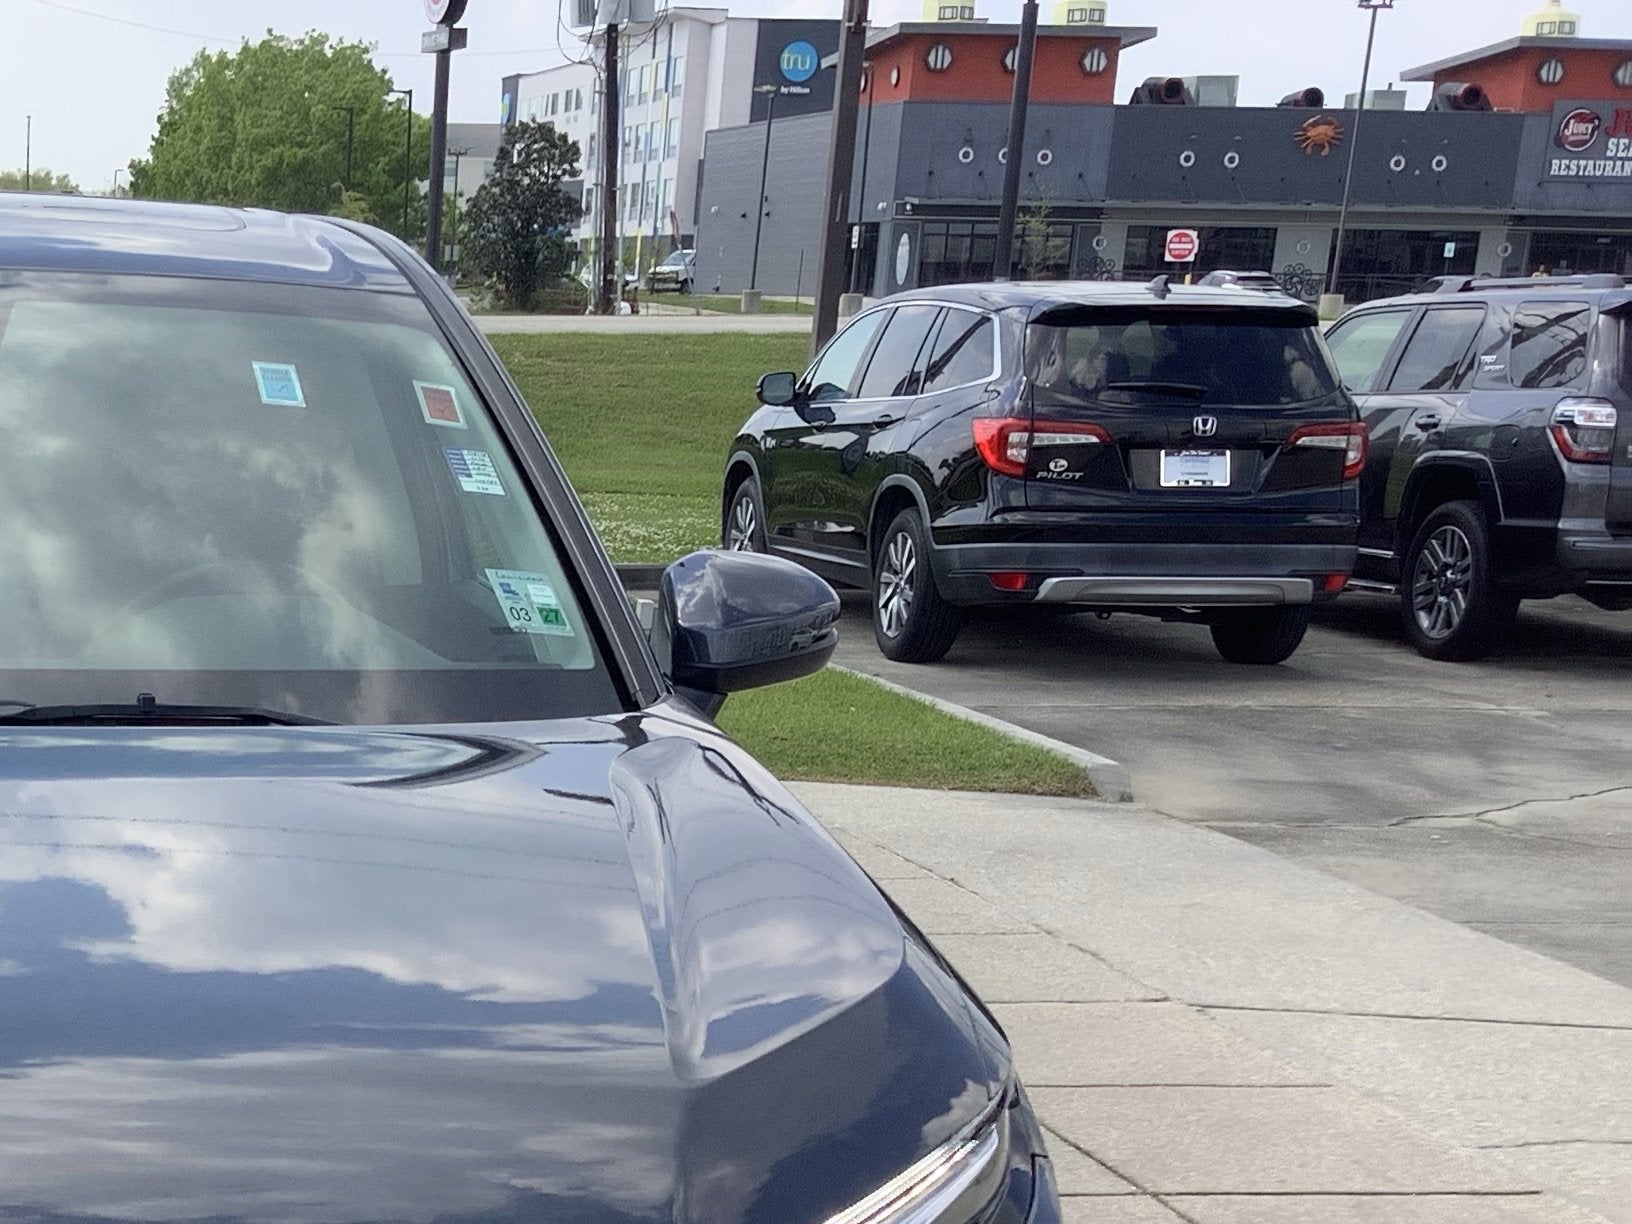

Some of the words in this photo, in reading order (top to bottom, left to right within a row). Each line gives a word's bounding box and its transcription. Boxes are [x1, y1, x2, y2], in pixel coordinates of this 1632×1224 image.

[1036, 471, 1085, 480] PILOT
[509, 606, 532, 622] 03
[539, 608, 560, 623] 27
